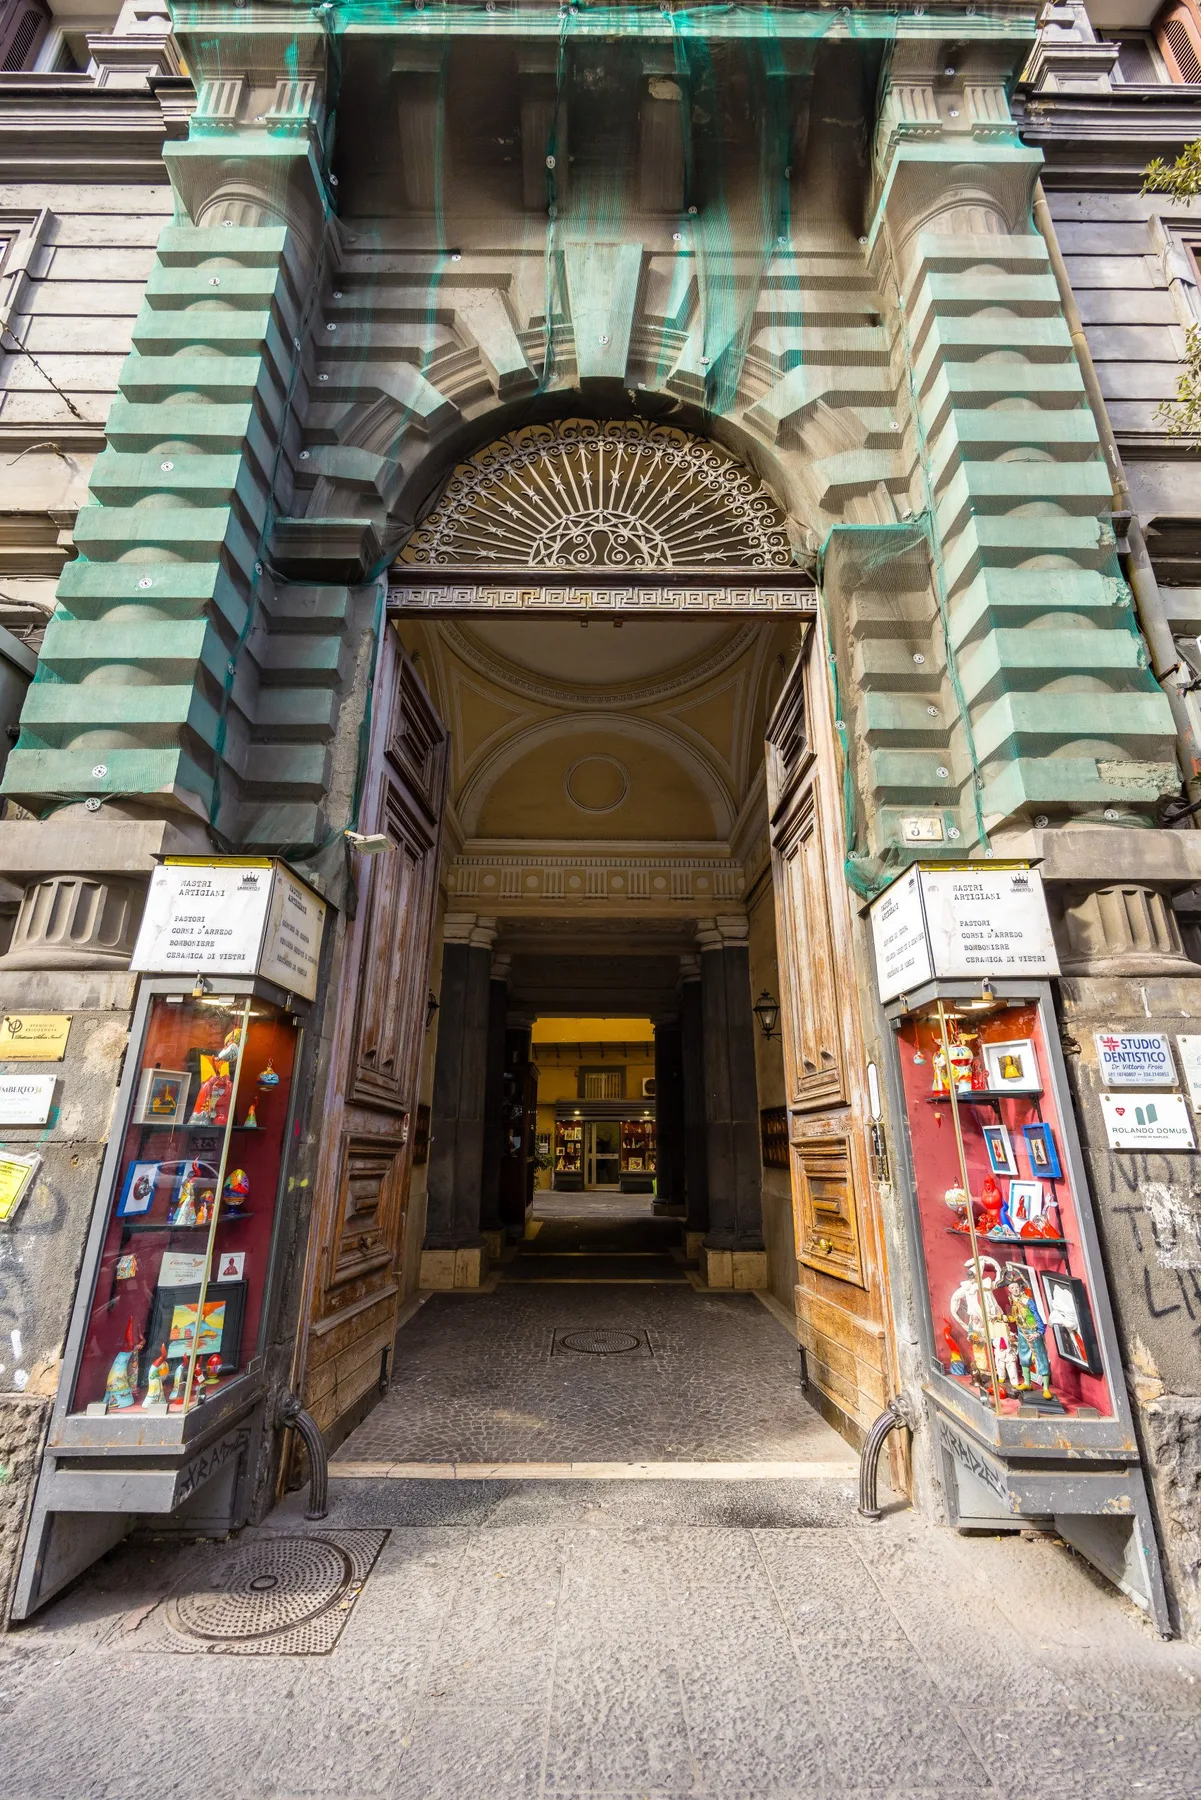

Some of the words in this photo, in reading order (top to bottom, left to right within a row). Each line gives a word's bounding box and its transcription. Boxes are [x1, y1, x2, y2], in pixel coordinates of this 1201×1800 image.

[909, 821, 937, 836] 34
[180, 880, 213, 888] MASTRI
[952, 884, 984, 892] MASTRI
[179, 889, 225, 897] ARTIGIANI
[954, 892, 1001, 901] ARTIGIANI
[174, 915, 205, 923] PASTORI
[171, 927, 194, 935] CORNI
[166, 952, 203, 960] CERAMICA
[1121, 1039, 1161, 1049] STUDIO
[1103, 1052, 1166, 1062] DENTISTICO
